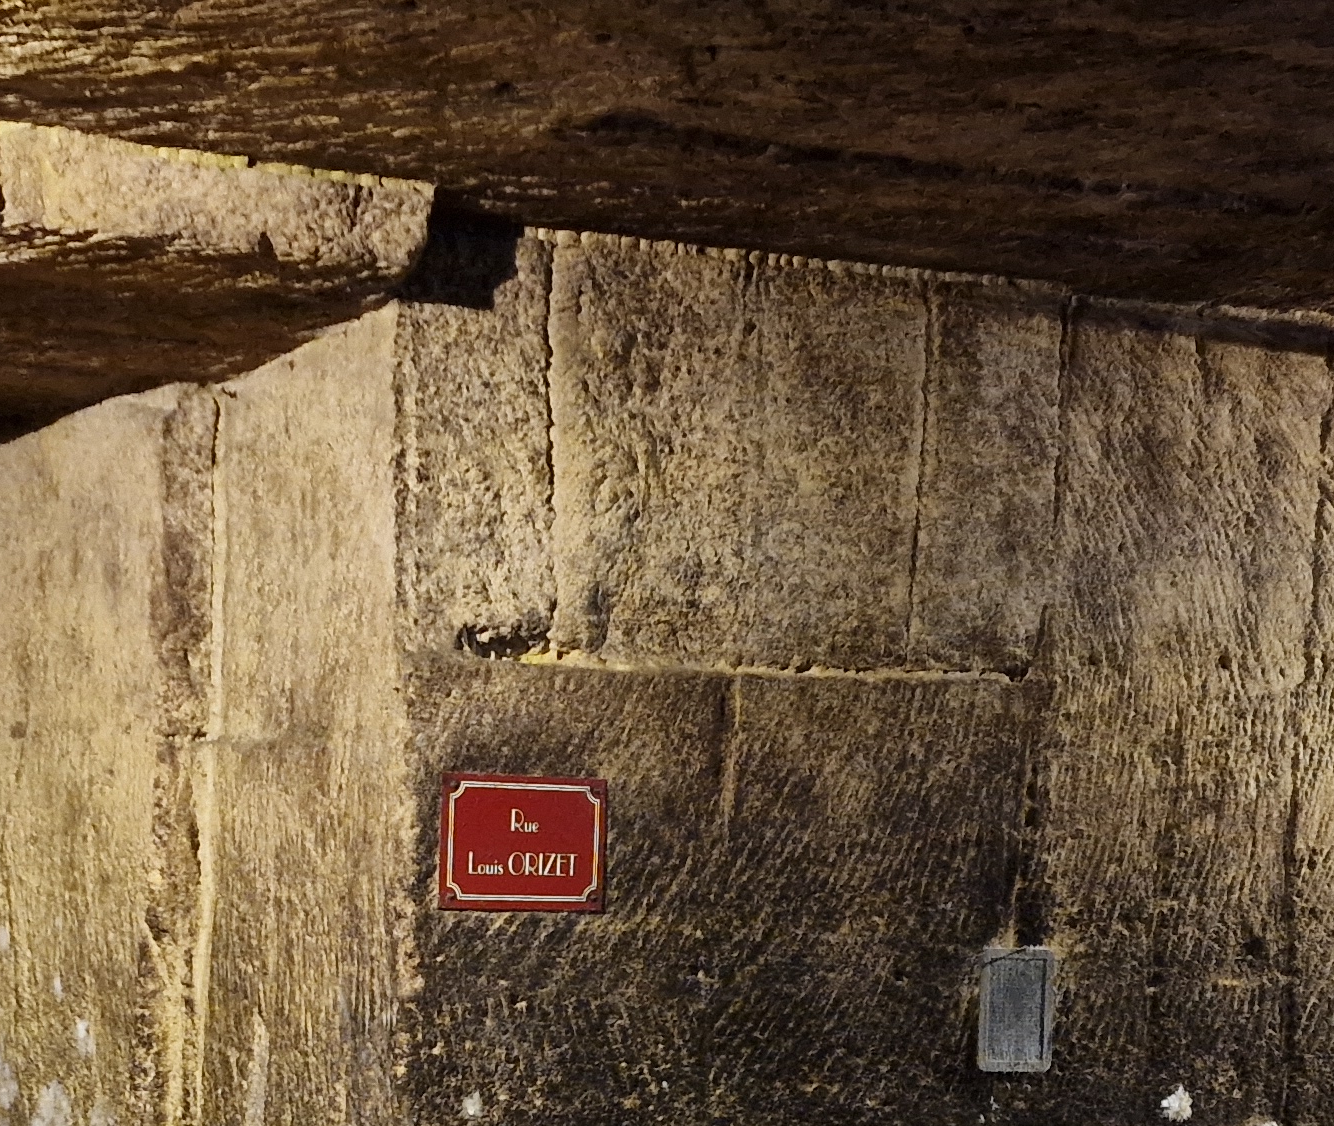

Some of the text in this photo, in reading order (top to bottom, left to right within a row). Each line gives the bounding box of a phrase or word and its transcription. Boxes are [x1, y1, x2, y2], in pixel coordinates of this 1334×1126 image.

[510, 808, 539, 833] Rue
[468, 851, 578, 877] Louis ORIZET
